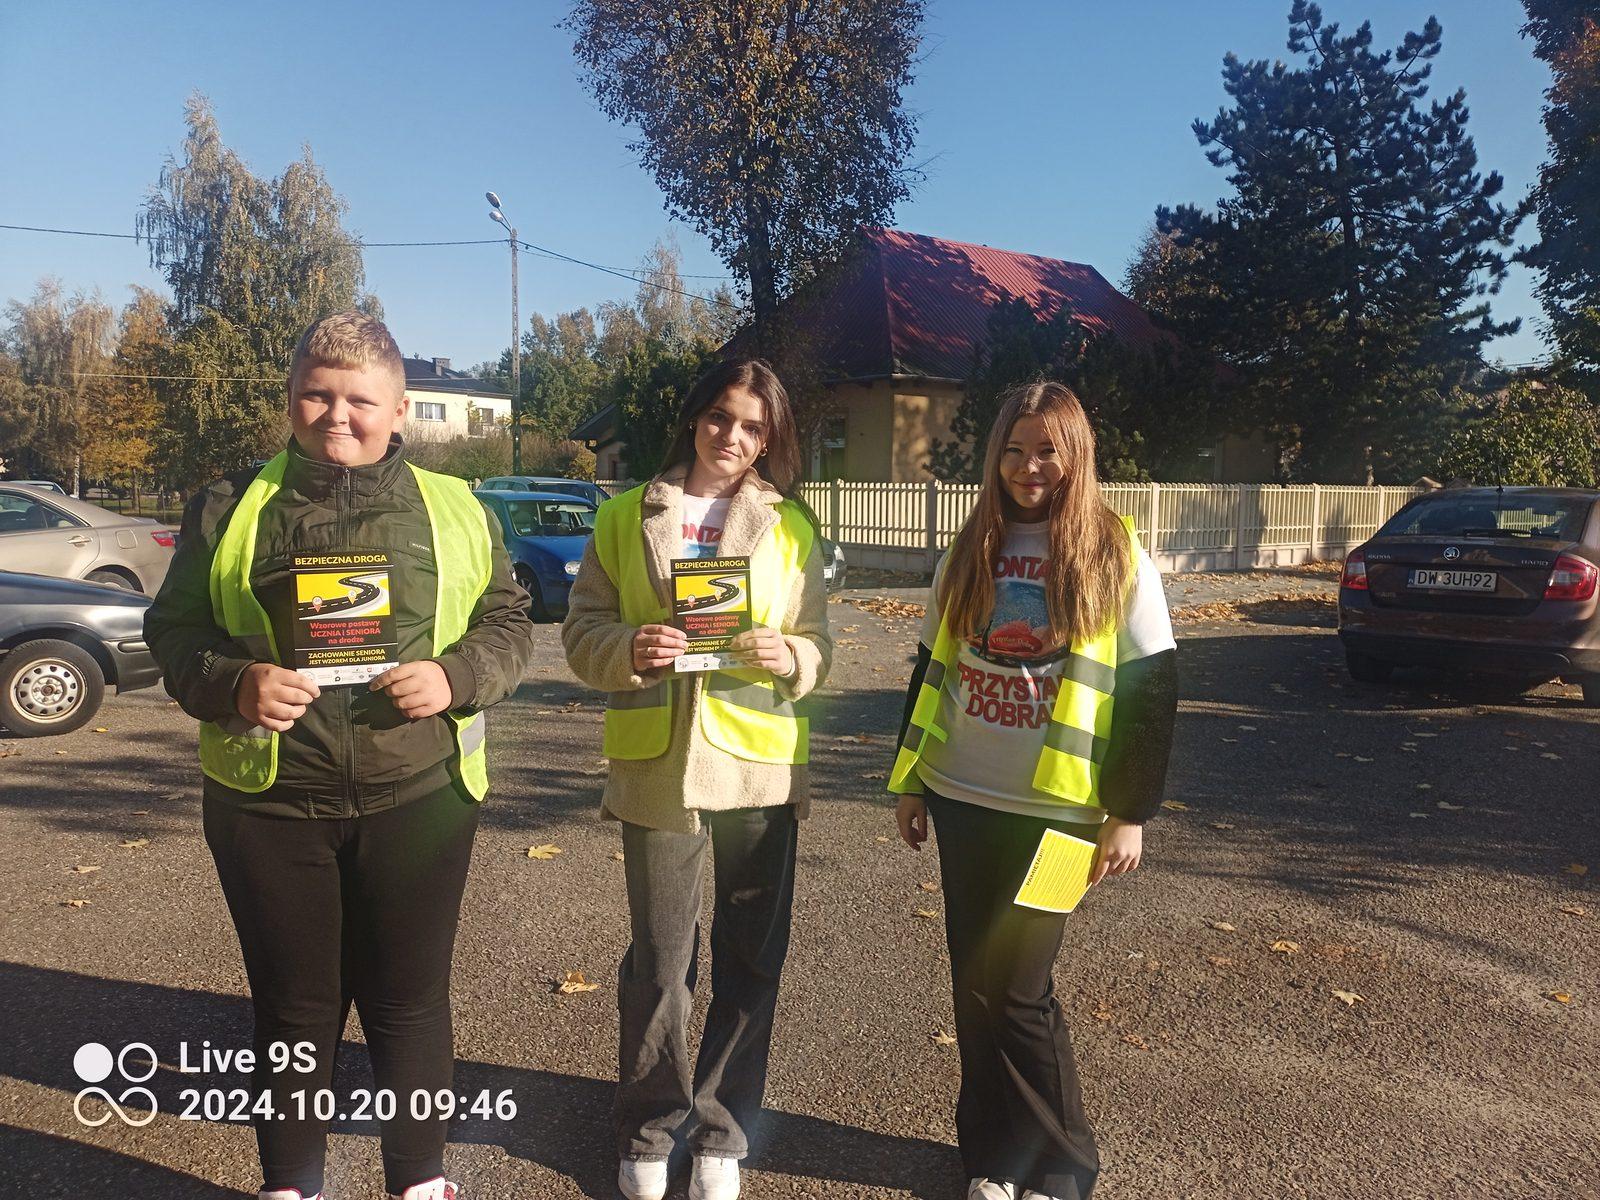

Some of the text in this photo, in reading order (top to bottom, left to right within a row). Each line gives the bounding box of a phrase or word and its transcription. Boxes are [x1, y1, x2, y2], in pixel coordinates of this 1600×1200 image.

[295, 554, 387, 565] BEZPIECZNA DROGA
[675, 561, 718, 569] BEZPIECZNA
[1417, 571, 1493, 588] DW 3UH92
[310, 620, 380, 629] Wzorowe postawy
[310, 630, 341, 638] UCZNIA
[346, 628, 381, 636] SENIORA
[340, 636, 364, 644] drodze
[687, 640, 719, 648] ACHOWANIE
[308, 648, 385, 659] ZACHOWANIE SENIORA
[957, 661, 1063, 701] PRZYSTA
[965, 693, 1053, 729] DOBRA
